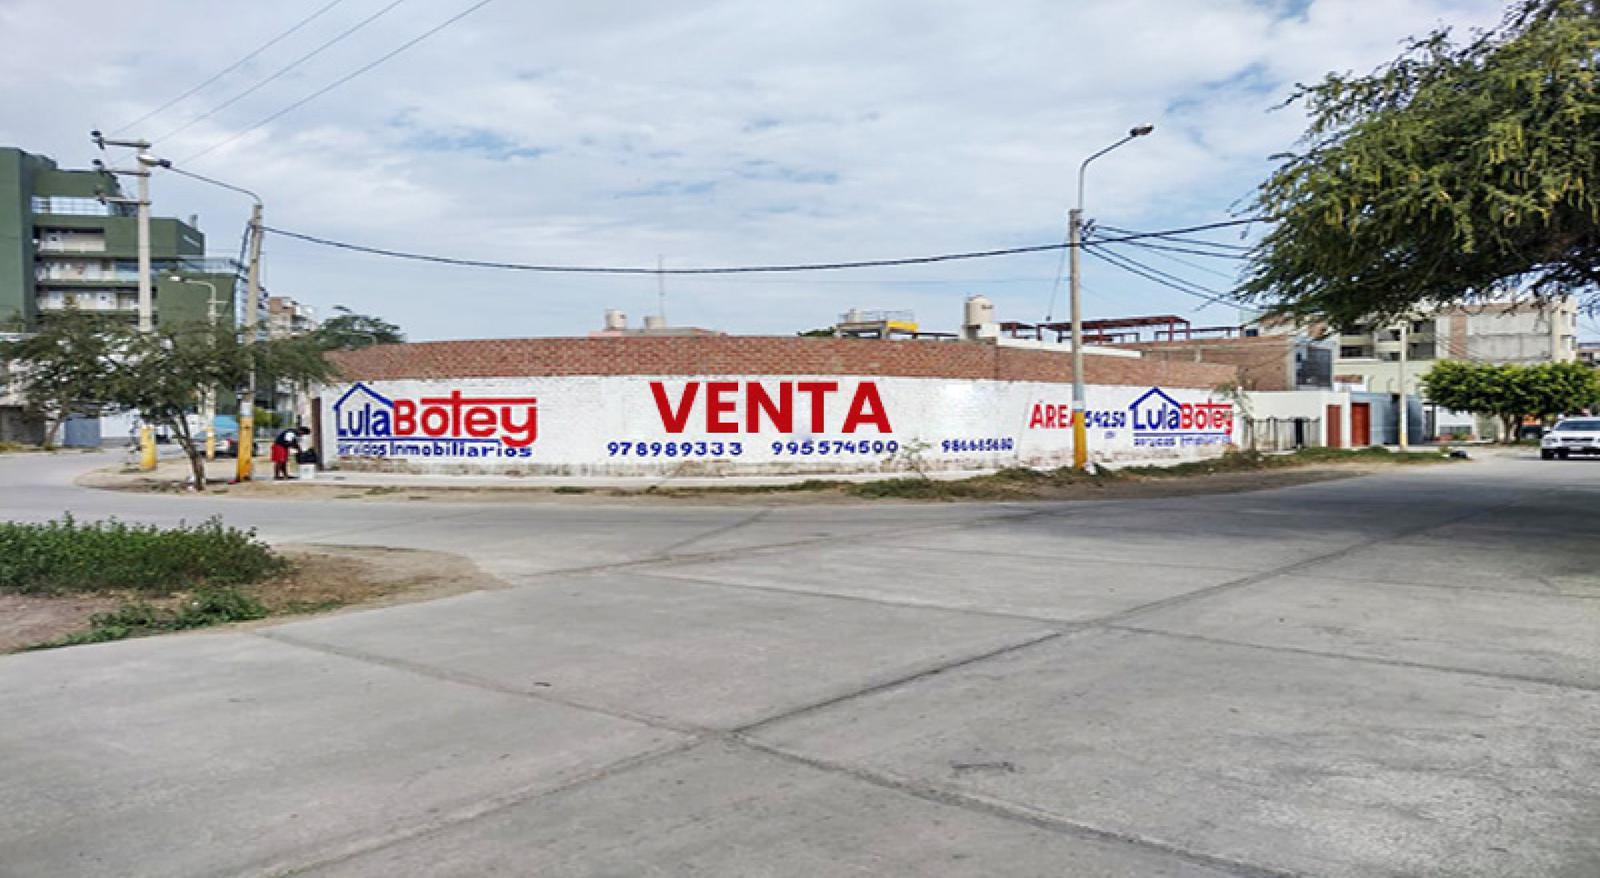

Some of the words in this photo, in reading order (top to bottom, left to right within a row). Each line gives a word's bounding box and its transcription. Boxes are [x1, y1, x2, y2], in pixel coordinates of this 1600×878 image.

[649, 381, 893, 433] VENTA
[607, 441, 743, 457] 978989333
[771, 440, 899, 456] 995574500
